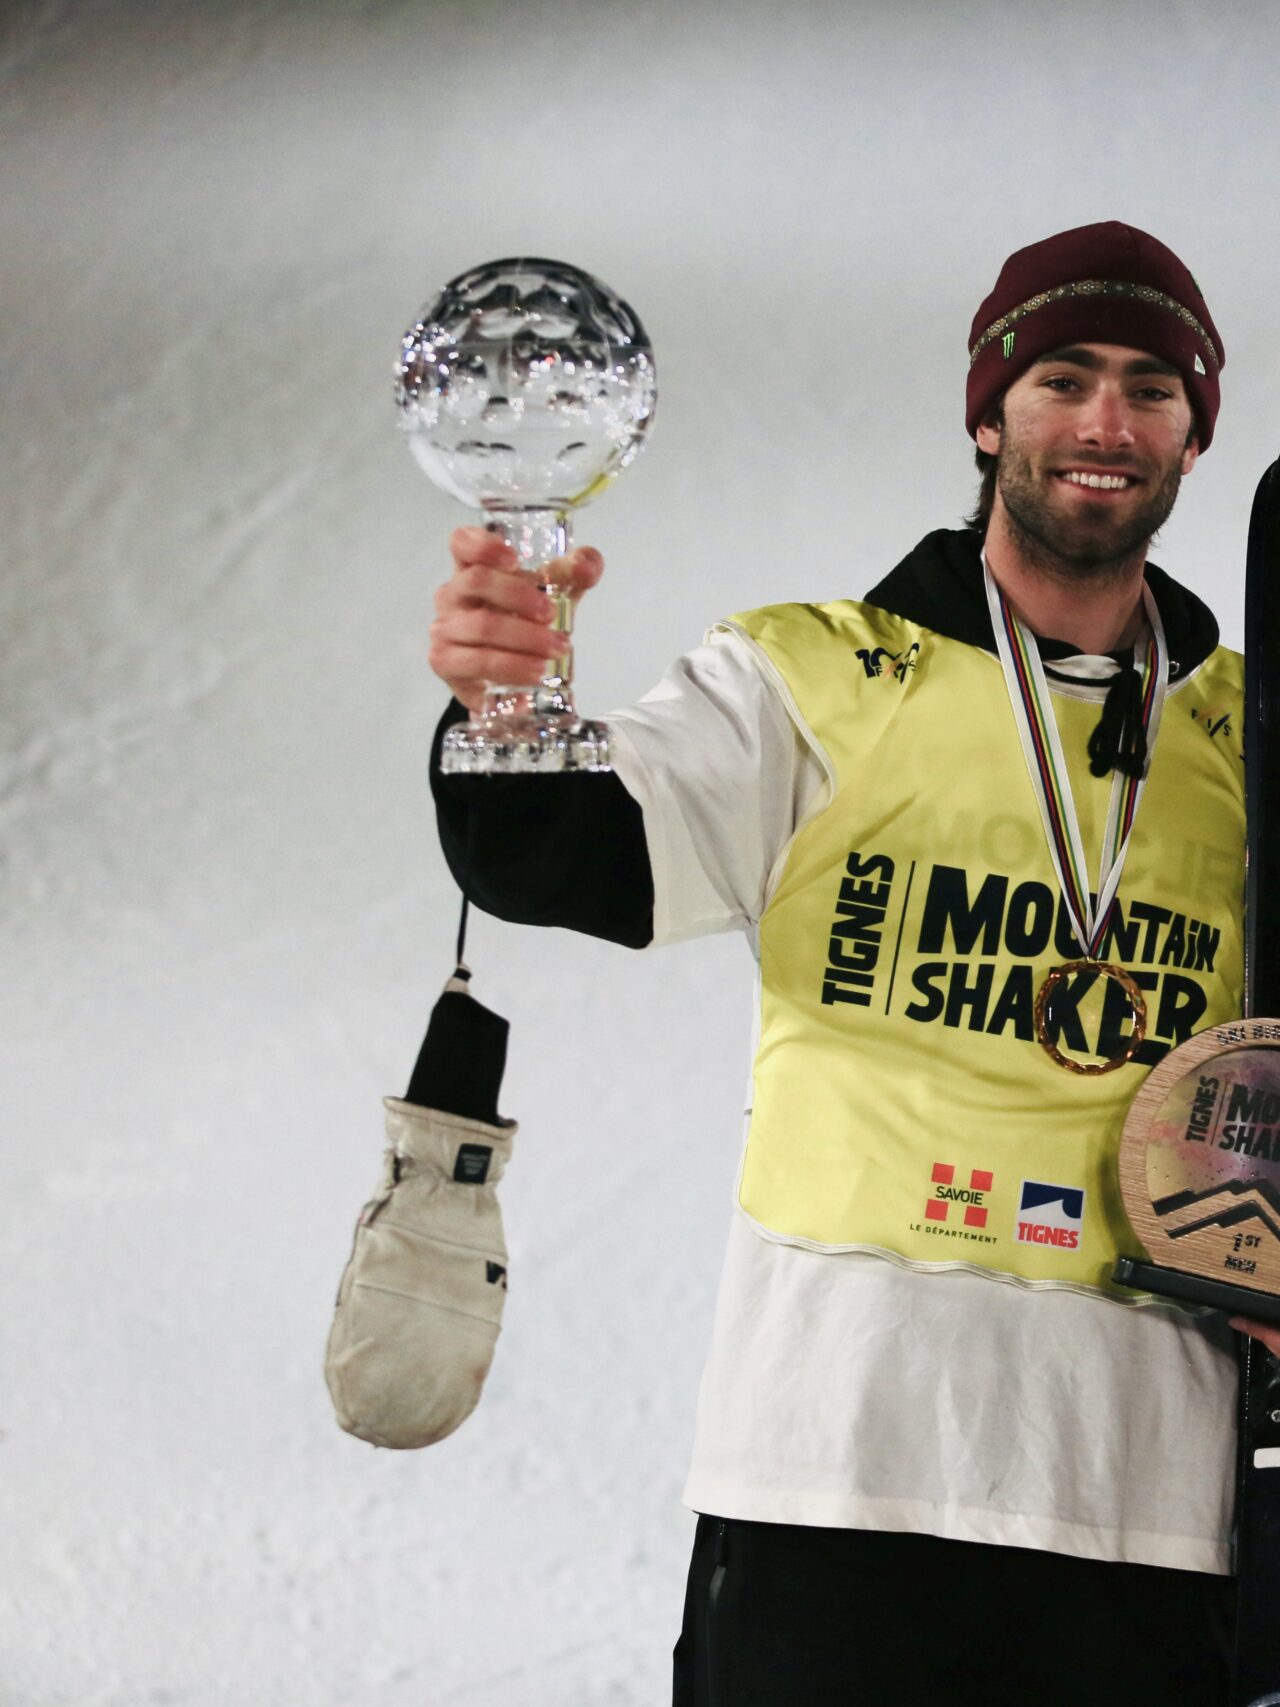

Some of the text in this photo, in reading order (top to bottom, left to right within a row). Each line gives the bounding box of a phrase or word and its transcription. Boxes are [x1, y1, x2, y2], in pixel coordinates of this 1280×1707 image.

[1191, 708, 1232, 737] FIS
[821, 851, 896, 1008] TIGNES
[916, 863, 1221, 973] MOUNTAIN
[904, 961, 1208, 1067] SHAKER
[1185, 1075, 1220, 1142] TIGNES
[936, 1186, 984, 1205] SAVOIE
[910, 1223, 998, 1244] LE DÉPARTEMENT
[1018, 1222, 1079, 1249] TIGNES
